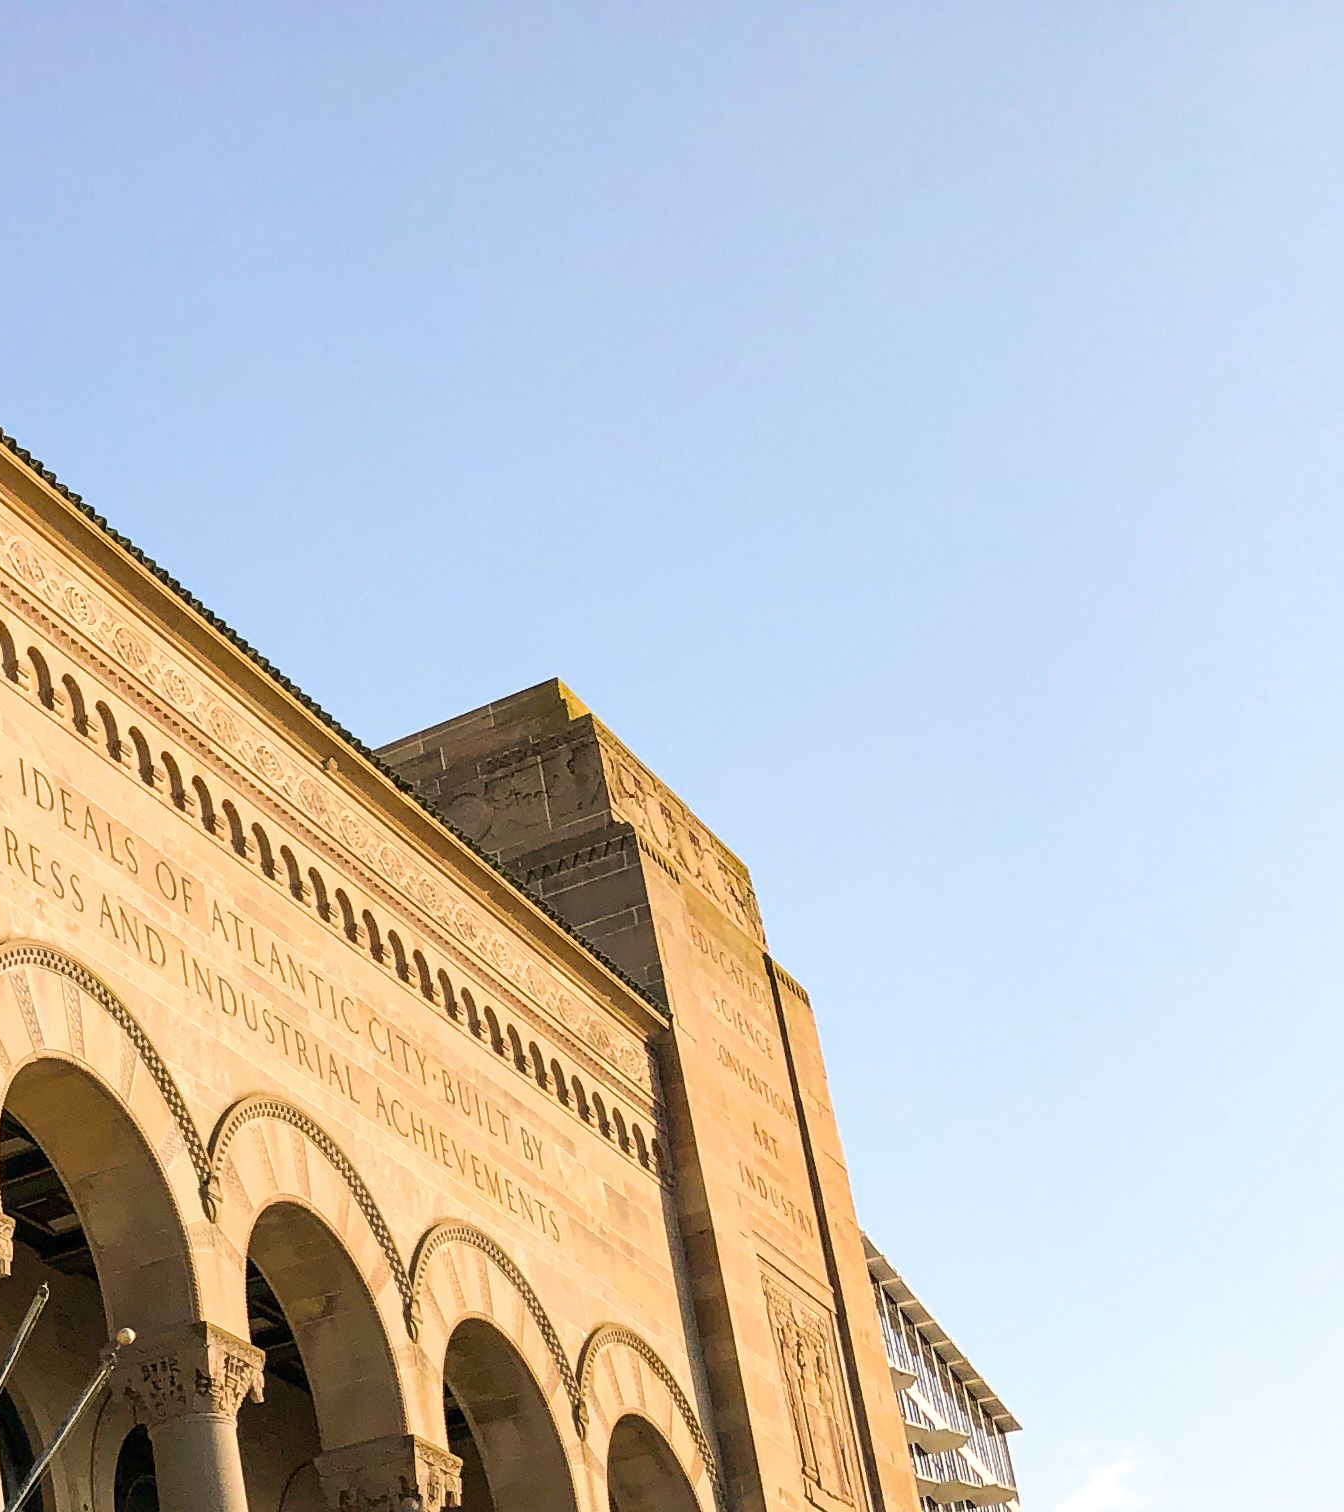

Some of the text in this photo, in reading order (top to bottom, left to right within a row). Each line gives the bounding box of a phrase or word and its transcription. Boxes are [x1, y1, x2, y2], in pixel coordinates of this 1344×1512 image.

[19, 758, 138, 874] IDEALS
[155, 861, 192, 913] OF
[212, 900, 359, 1034] ATLANTIC
[442, 1069, 510, 1145] BUILT
[520, 1126, 544, 1170] BY
[690, 924, 773, 1013] EDUCATION
[712, 990, 773, 1060] SCIENCE
[100, 893, 166, 968] AND
[180, 949, 360, 1104] INDUSTRIAL
[376, 1087, 560, 1241] ACHIEVEMENTS
[752, 1121, 779, 1160] ART
[738, 1160, 814, 1238] INDUSTRY
